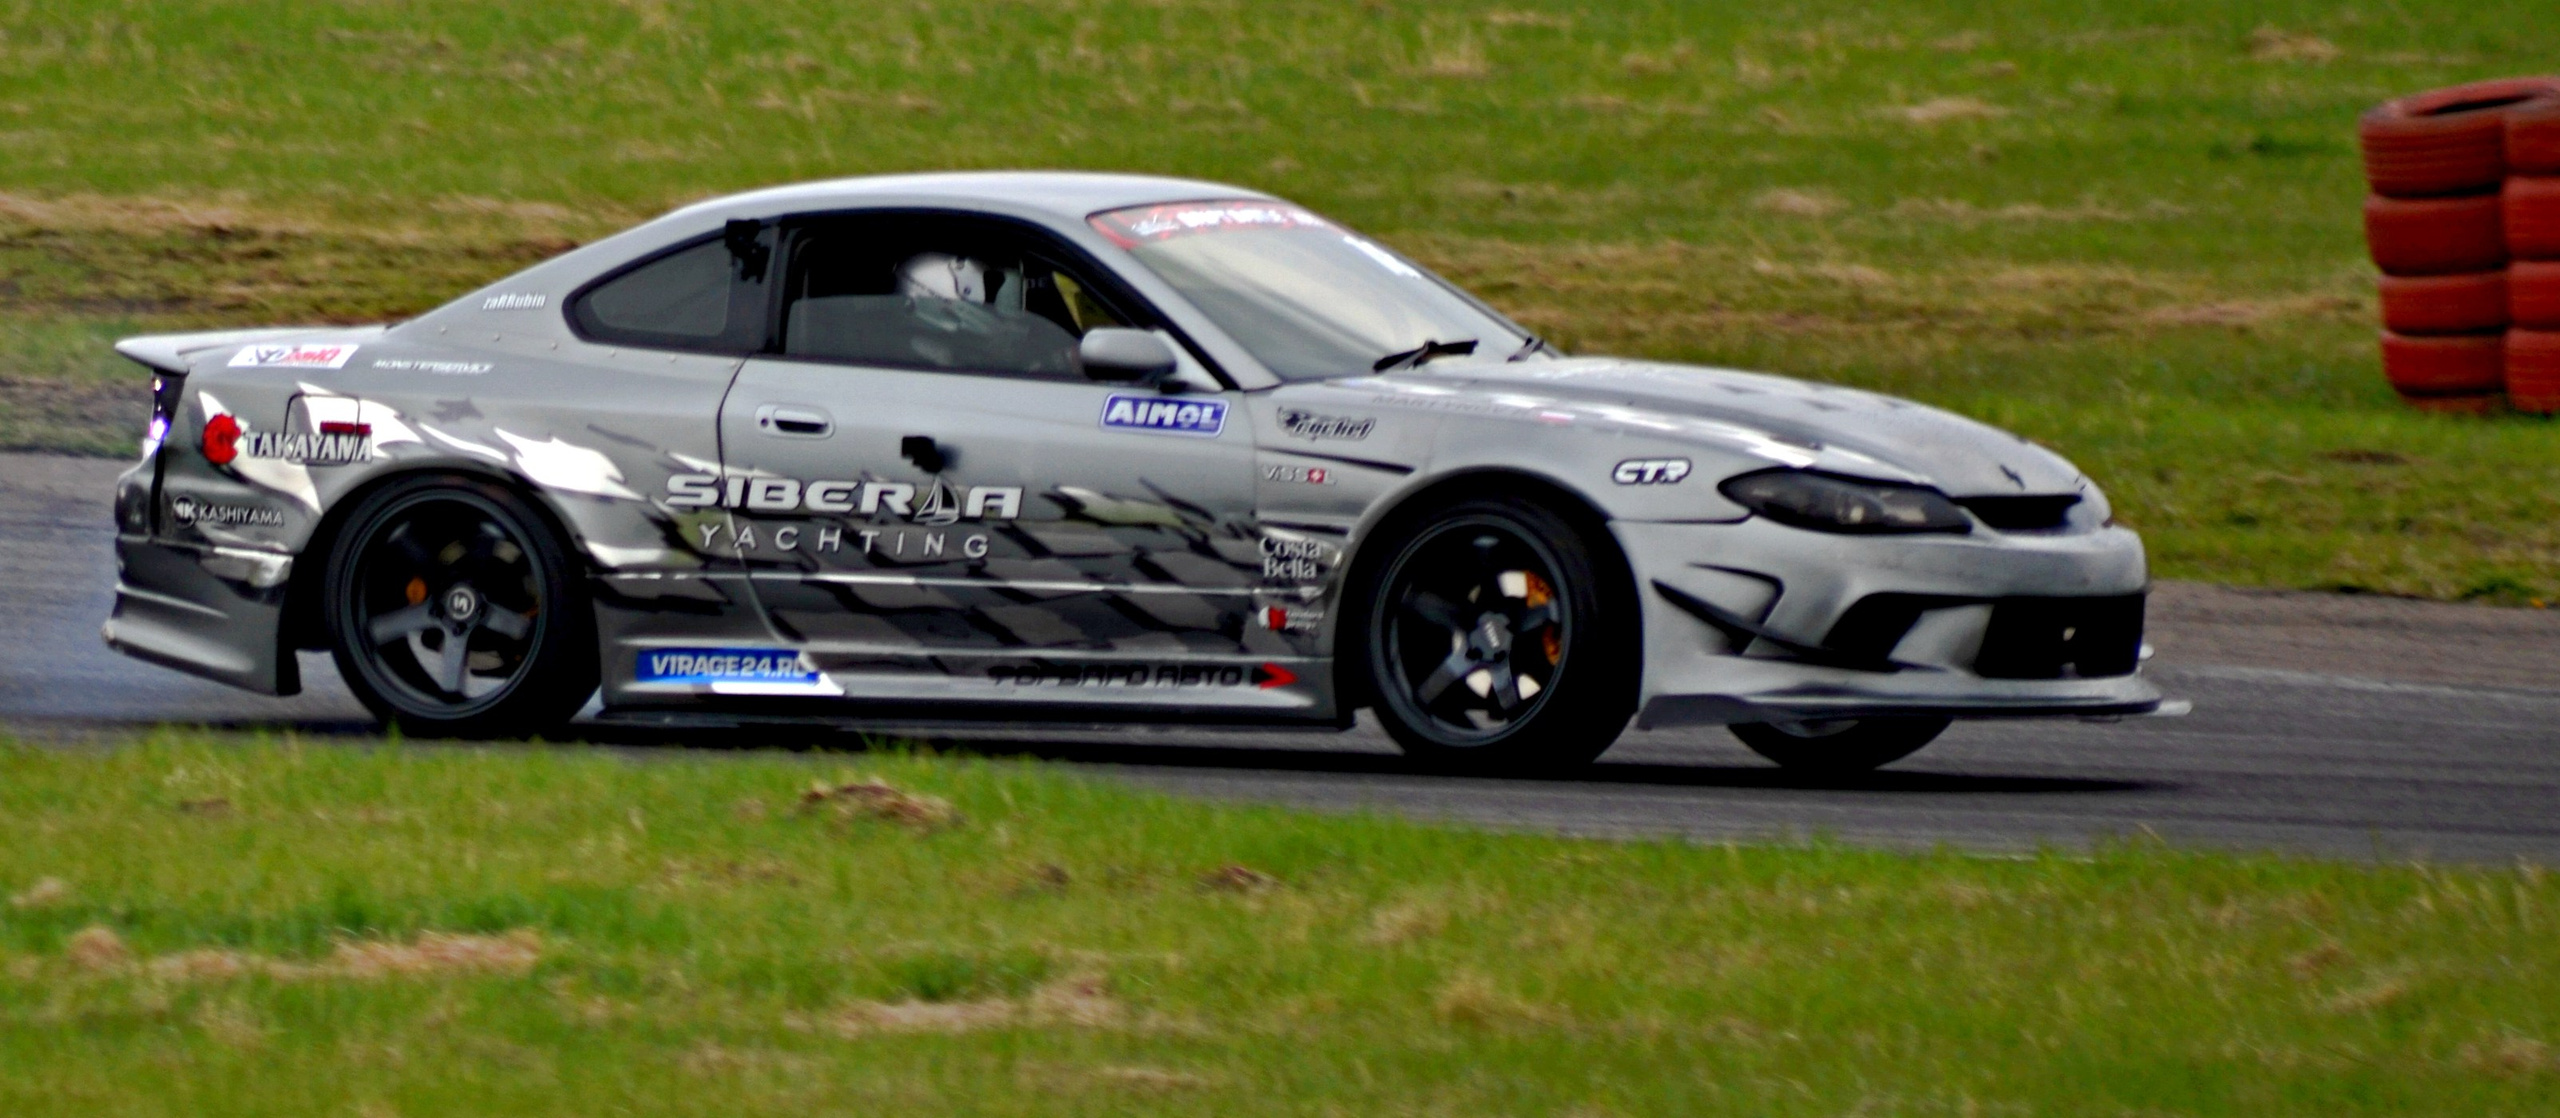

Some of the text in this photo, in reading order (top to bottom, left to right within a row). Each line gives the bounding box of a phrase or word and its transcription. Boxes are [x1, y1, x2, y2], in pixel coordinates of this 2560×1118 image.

[1105, 401, 1221, 430] AIMOL
[245, 431, 373, 463] TAKAYAMA
[198, 503, 286, 528] KASHIYAMA
[698, 522, 992, 560] YACHTING
[1259, 536, 1322, 559] Costa
[1263, 556, 1318, 580] Bella
